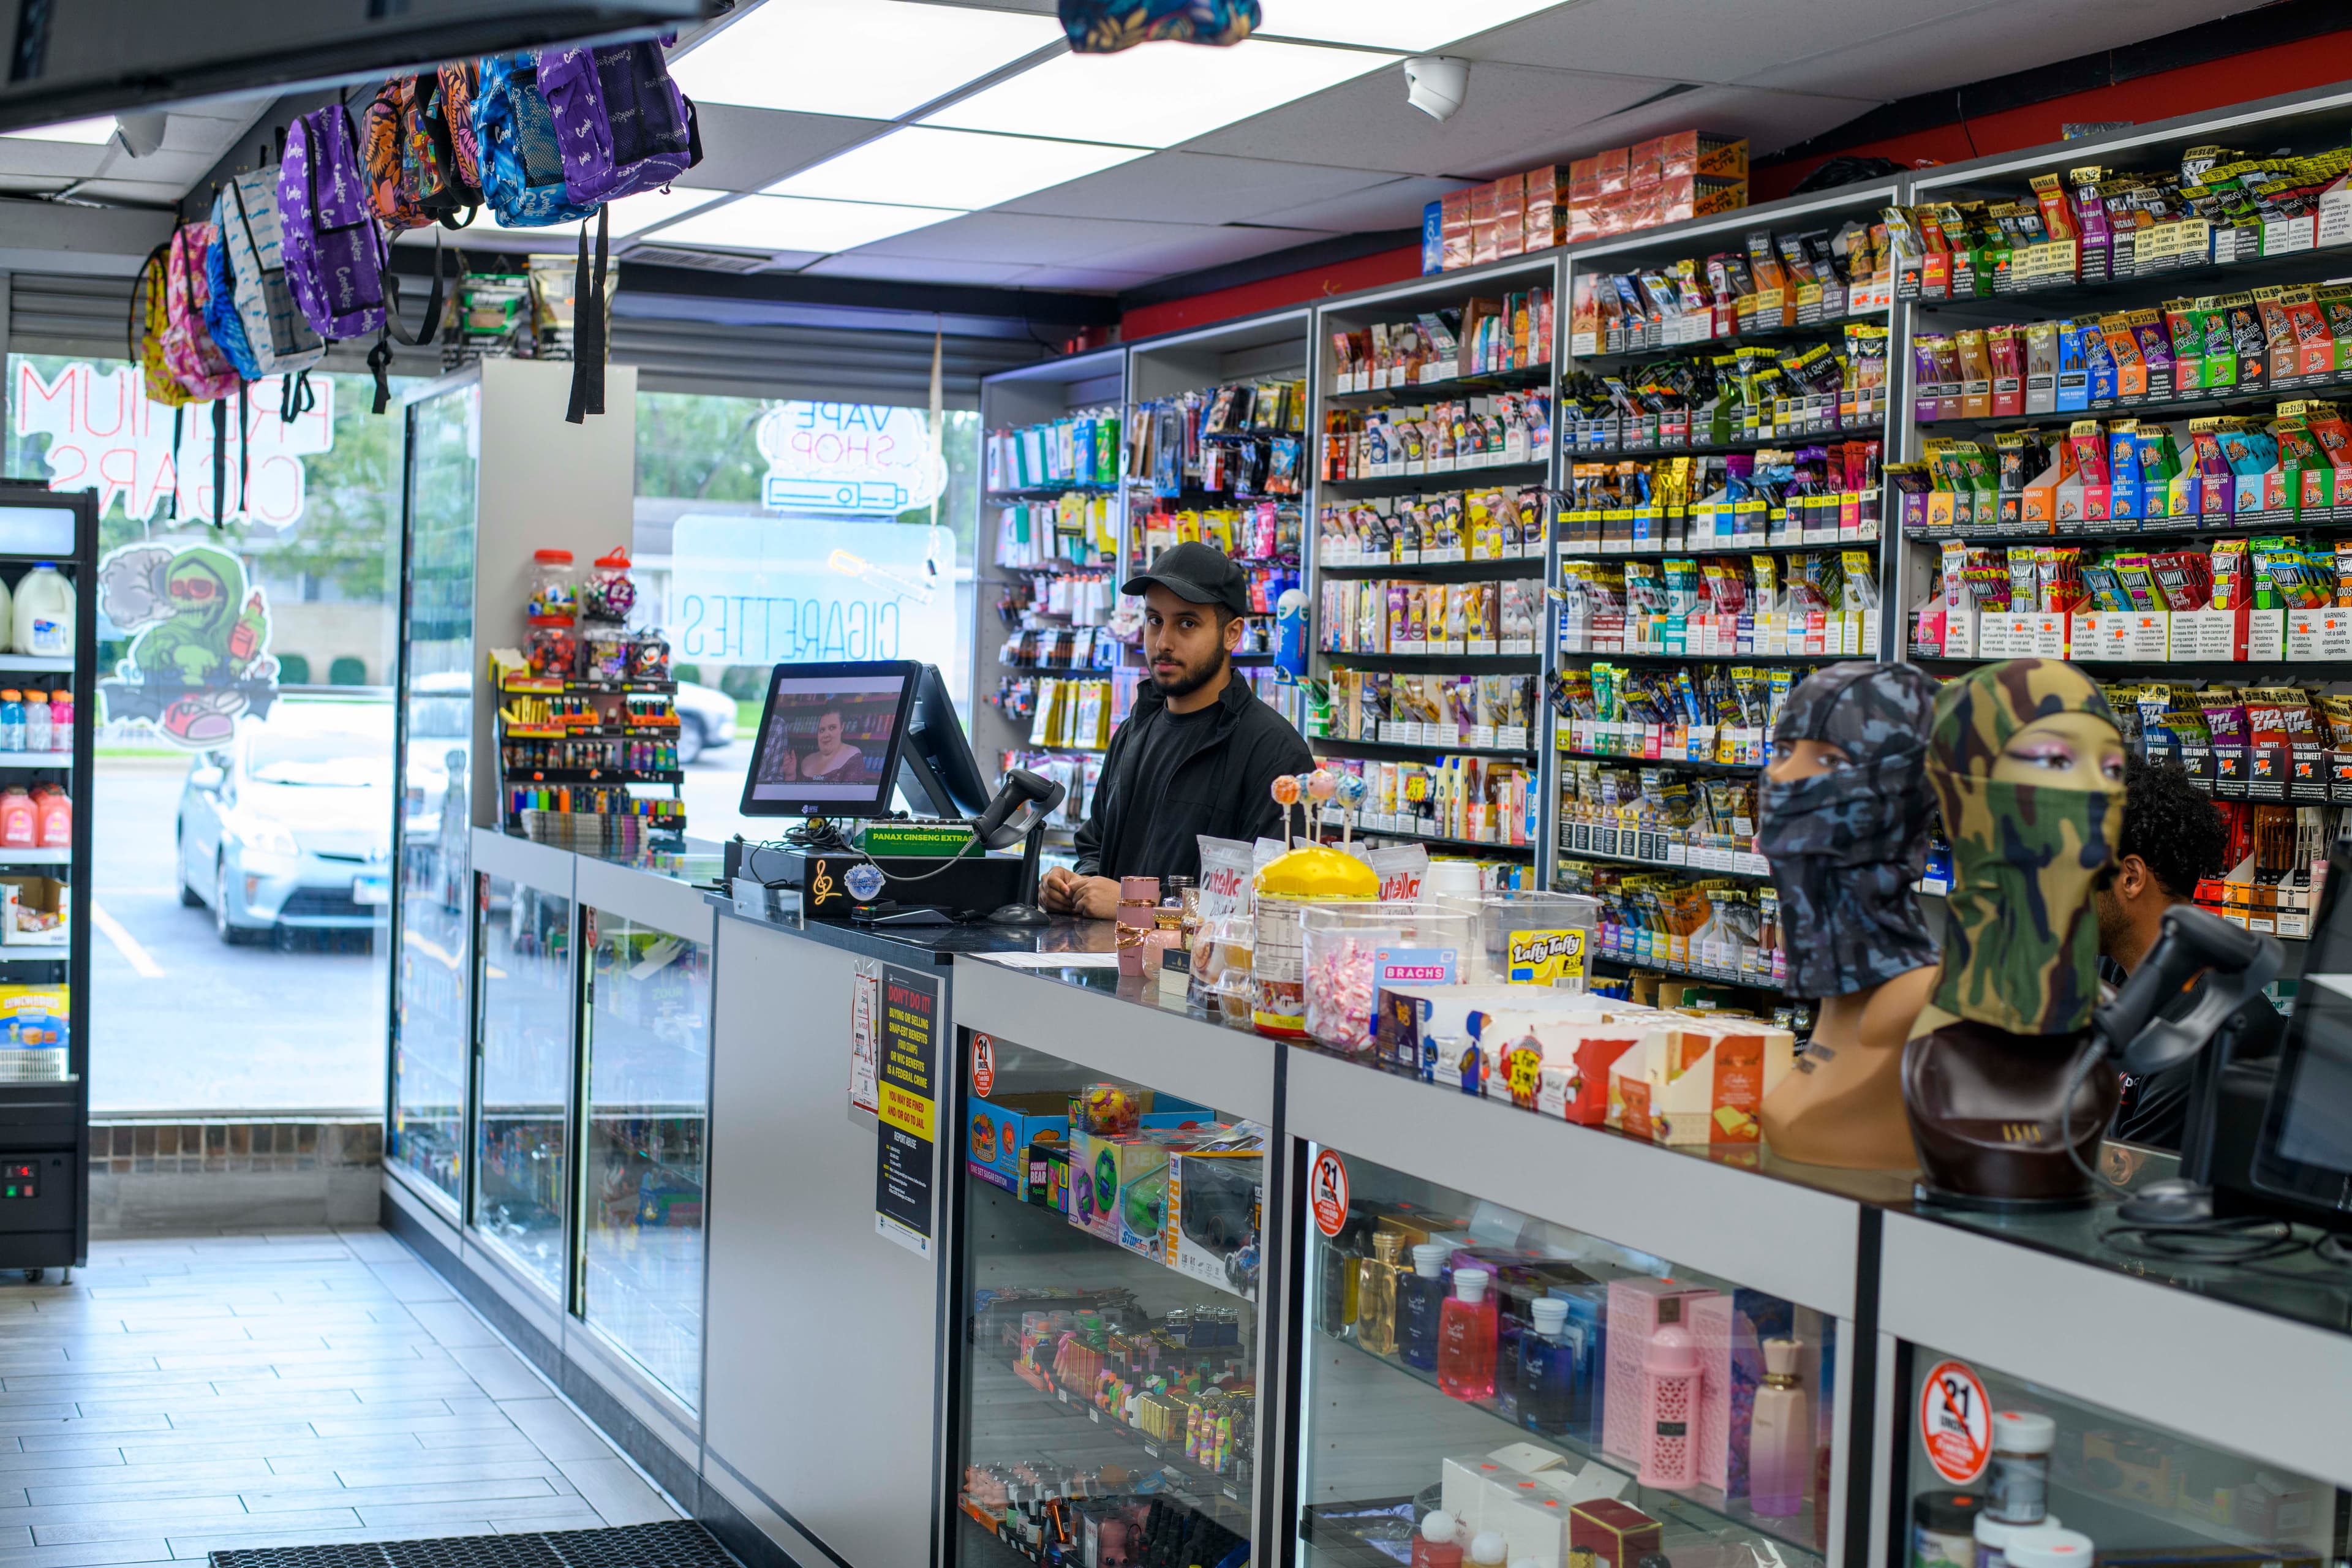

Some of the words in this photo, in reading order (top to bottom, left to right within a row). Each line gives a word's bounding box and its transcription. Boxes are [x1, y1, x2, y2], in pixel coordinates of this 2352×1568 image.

[1700, 148, 1733, 170] SOLAR
[333, 163, 346, 203] Cookies
[1696, 191, 1730, 214] SOLAR
[2218, 190, 2241, 204] JINGO
[2143, 200, 2166, 214] HD
[2279, 200, 2301, 212] JINGO
[2018, 216, 2040, 230] HD
[2114, 232, 2135, 243] COGNAC
[336, 266, 353, 309] Cookies
[2206, 328, 2230, 347] Wraps
[2234, 322, 2260, 342] Wraps
[2267, 320, 2291, 338] Wraps
[2298, 322, 2325, 341] Wraps
[2035, 342, 2049, 350] LEAF
[2175, 331, 2200, 350] Wraps
[2087, 344, 2108, 360] Wraps
[2146, 340, 2168, 359] Wraps
[2118, 349, 2139, 368] Wraps
[2307, 360, 2325, 372] Wraps
[2275, 364, 2294, 377] Wraps
[2321, 431, 2346, 448] 4K's
[2113, 442, 2133, 461] 4K's
[2199, 441, 2220, 459] 4K's
[2225, 443, 2248, 458] 4K's
[2291, 441, 2315, 456] 4K's
[2122, 571, 2147, 587] SHOW
[2158, 569, 2184, 586] SHOW
[2272, 568, 2299, 584] SHOW
[609, 584, 631, 601] EZ
[2255, 581, 2272, 591] GREEN
[2132, 597, 2152, 606] Tropical
[2168, 591, 2185, 600] Black
[2171, 597, 2190, 608] Cherry
[2291, 599, 2307, 609] Fruity
[2211, 695, 2232, 704] $1.29
[2245, 692, 2252, 701] 5
[2275, 693, 2282, 702] 5
[2287, 693, 2306, 703] $1.29
[2207, 712, 2231, 725] CITY
[2249, 709, 2281, 721] CITY
[2283, 710, 2307, 722] CITY
[2211, 722, 2238, 735] LIFE
[2253, 718, 2285, 732] LIFE
[2286, 719, 2313, 733] LIFE
[941, 834, 975, 843] EXTRAC
[1201, 867, 1243, 898] nutella
[1379, 872, 1422, 900] utella
[1513, 941, 1548, 964] Laffy
[1547, 934, 1581, 956] Taffy
[888, 985, 909, 1006] DON'T
[910, 992, 921, 1009] DO
[921, 995, 930, 1014] IT!
[889, 1007, 904, 1021] BUYING
[905, 1012, 911, 1024] OR
[911, 1014, 929, 1030] SELLING
[889, 1022, 908, 1038] SNAP-EBT
[908, 1028, 928, 1044] BENEFITS
[978, 1039, 987, 1060] 21
[891, 1050, 897, 1061] OR
[905, 1056, 925, 1072] BENEFITS
[887, 1063, 892, 1074] IS
[892, 1066, 895, 1076] A
[895, 1067, 913, 1083] FEDERAL
[914, 1074, 927, 1088] CRIME
[897, 1093, 906, 1106] MAY
[906, 1098, 911, 1108] BE
[912, 1099, 924, 1113] FINED
[904, 1112, 910, 1123] GO
[910, 1114, 916, 1125] TO
[916, 1117, 924, 1129] JAIL
[894, 1131, 906, 1145] REPORT
[906, 1136, 916, 1149] ABUSE
[1030, 1161, 1047, 1171] GUMMY
[984, 1168, 995, 1180] SUGAR
[995, 1172, 1008, 1187] EDITION
[1030, 1171, 1047, 1184] BEAR
[1322, 1161, 1337, 1190] 21
[1166, 1180, 1180, 1269] RACING
[1121, 1231, 1143, 1246] STUNT
[1943, 1378, 1970, 1419] 21
